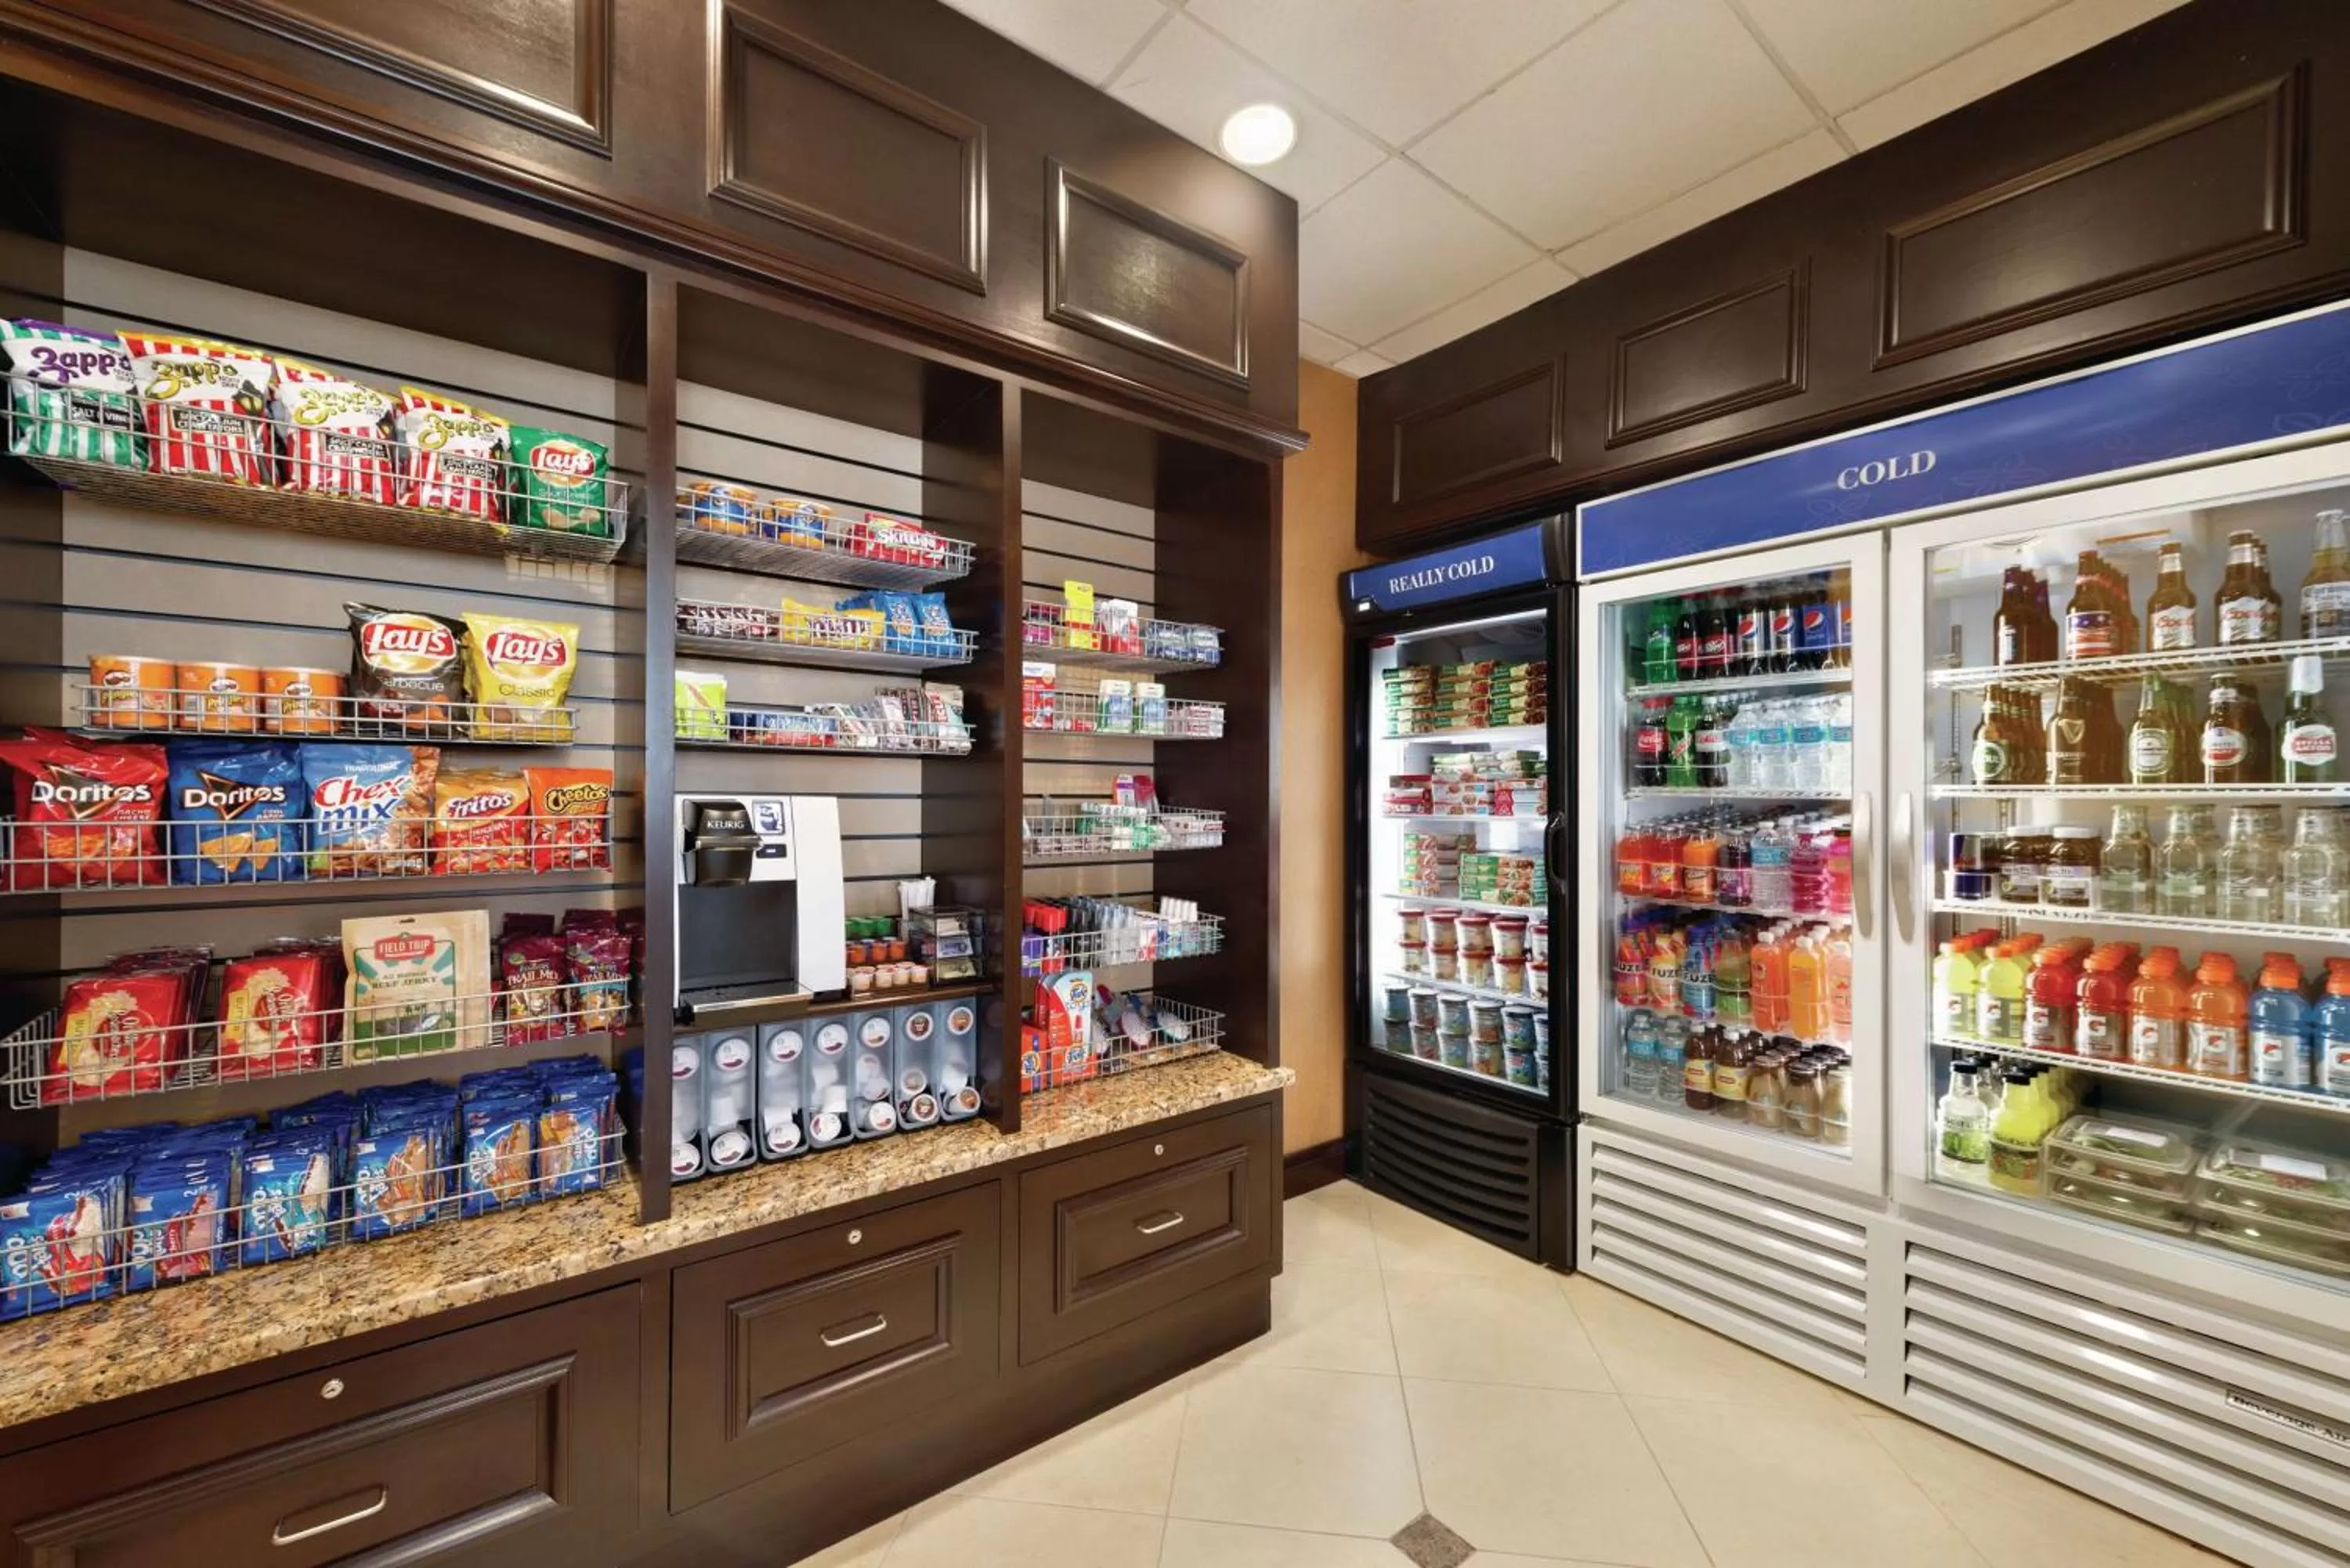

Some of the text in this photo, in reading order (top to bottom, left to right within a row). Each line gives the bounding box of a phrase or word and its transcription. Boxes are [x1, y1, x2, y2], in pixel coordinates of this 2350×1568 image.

[1837, 450, 1936, 490] COLD
[1389, 555, 1495, 595] REALLY COLD
[368, 623, 448, 659] Lay's
[493, 633, 562, 666] Lay's
[498, 683, 556, 698] Classic
[32, 781, 151, 804] Doritos
[183, 785, 286, 808] Doritos
[313, 775, 409, 807] Chex
[546, 784, 609, 811] Cheetos
[448, 792, 513, 818] Fritos
[707, 819, 745, 829] KEURIG
[378, 939, 431, 954] FIELD TRIP
